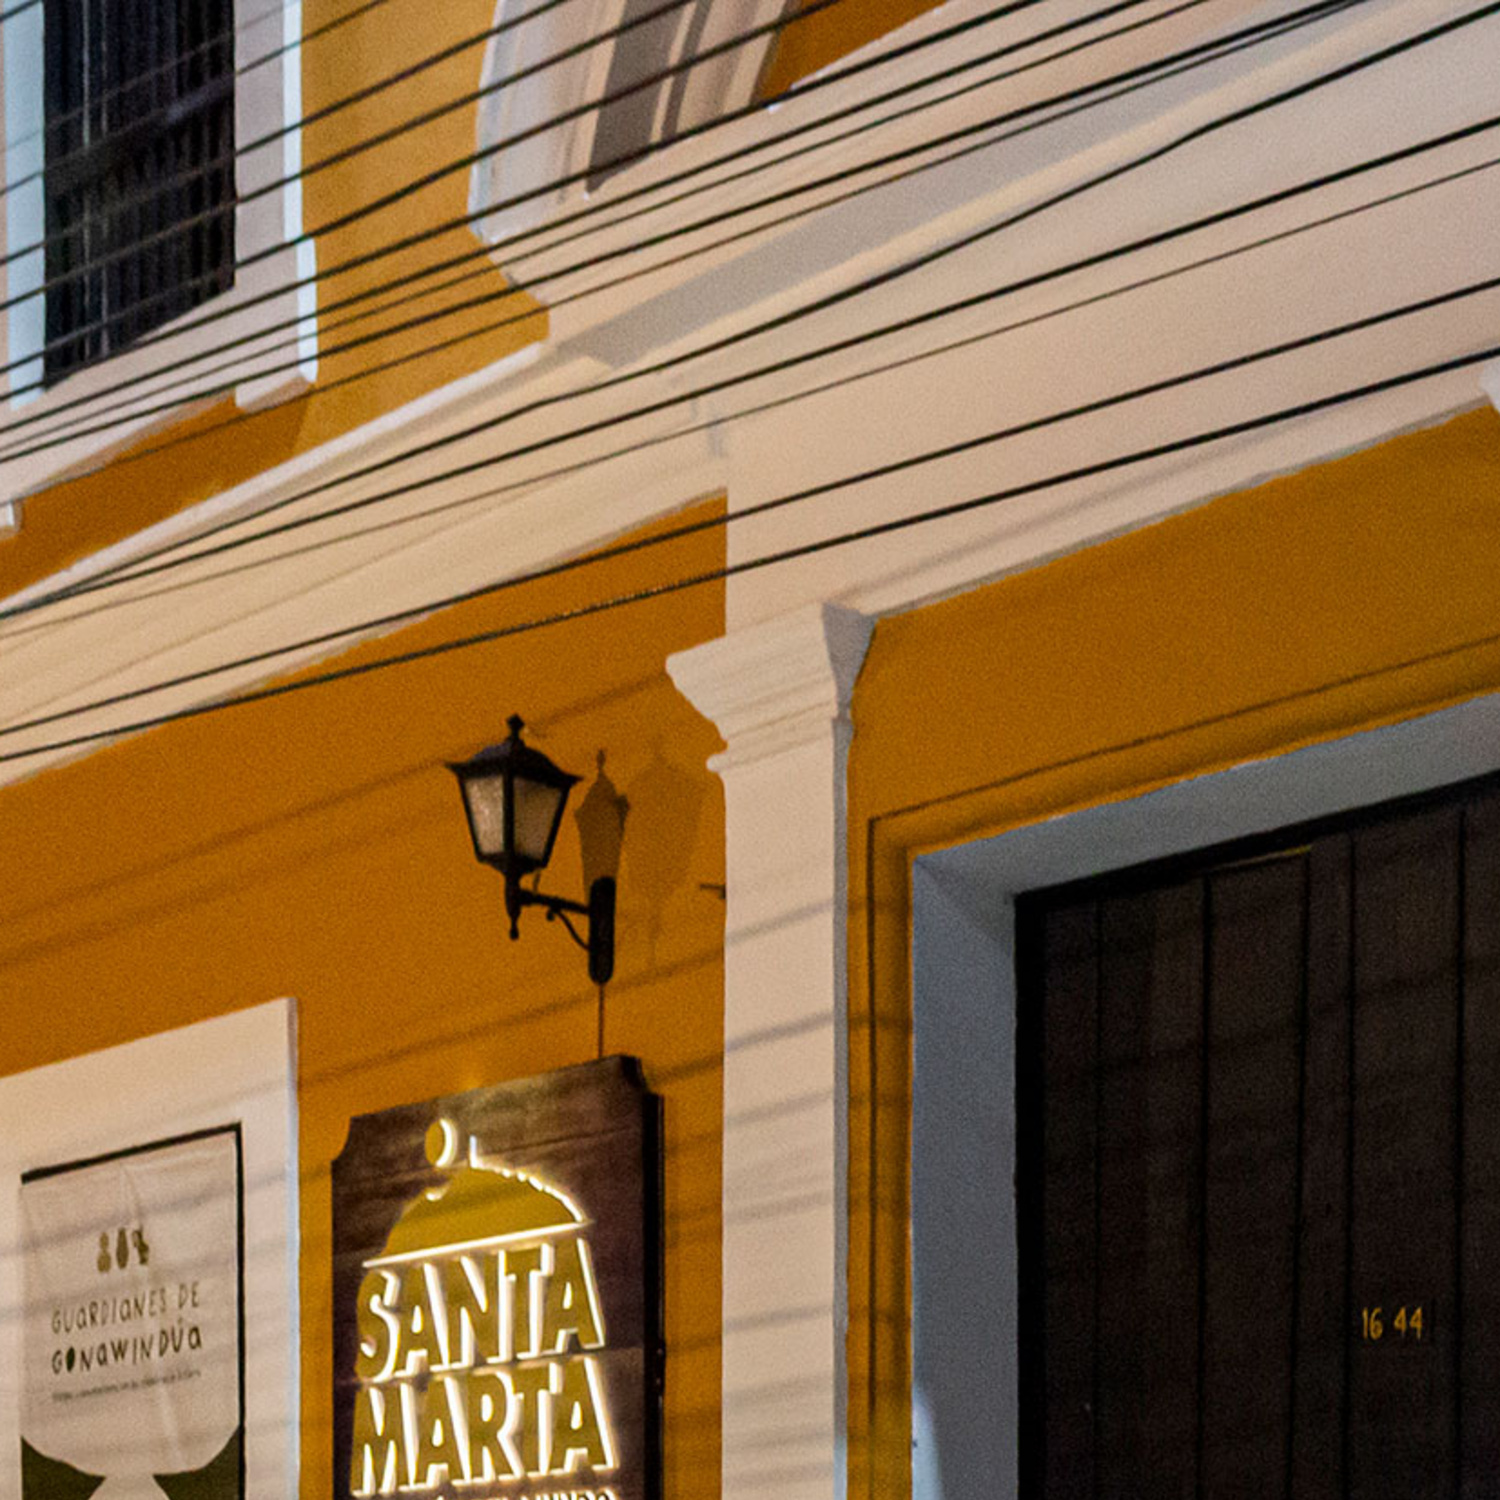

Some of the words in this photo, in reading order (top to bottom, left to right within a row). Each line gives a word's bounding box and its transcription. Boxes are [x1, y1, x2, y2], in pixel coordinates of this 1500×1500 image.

[178, 1281, 200, 1309] DE
[355, 1238, 605, 1383] SANTA
[1362, 1306, 1383, 1340] 16
[1394, 1306, 1422, 1340] 44
[351, 1357, 618, 1497] MARTA
